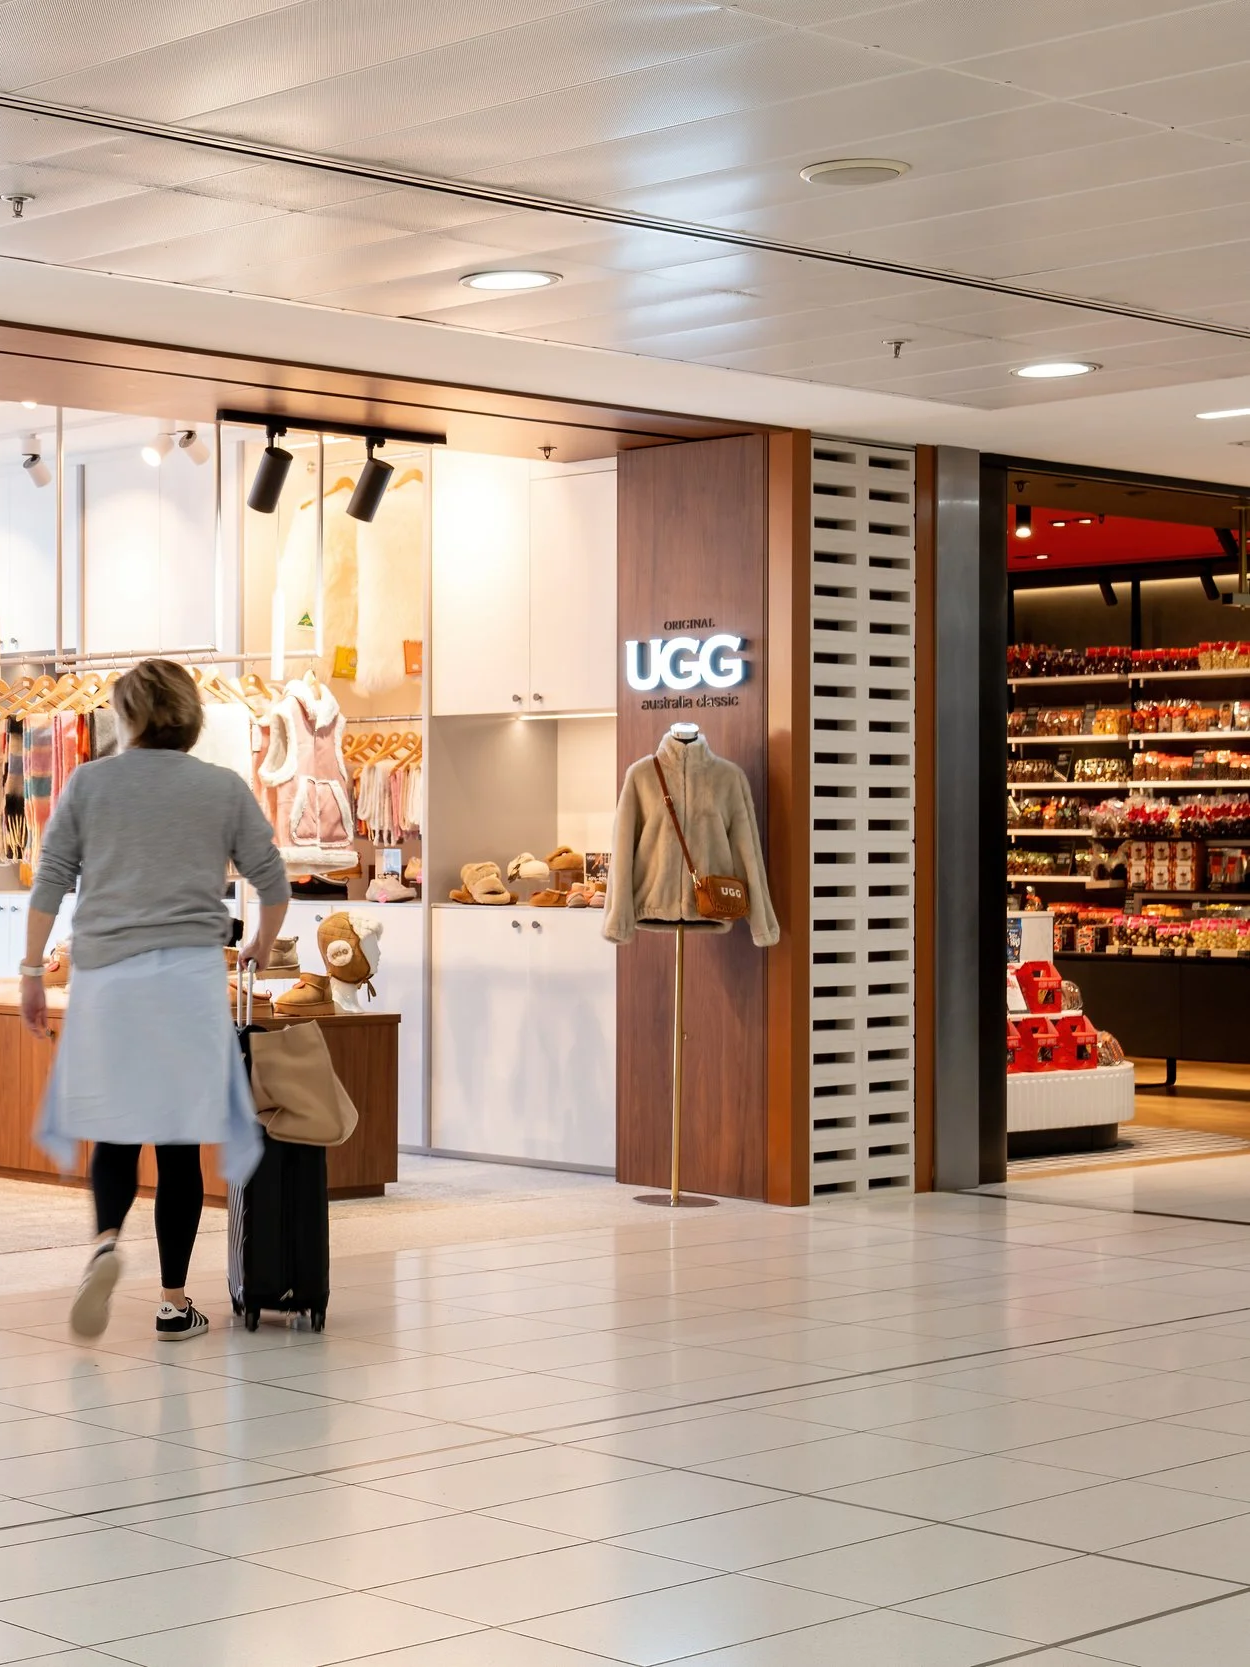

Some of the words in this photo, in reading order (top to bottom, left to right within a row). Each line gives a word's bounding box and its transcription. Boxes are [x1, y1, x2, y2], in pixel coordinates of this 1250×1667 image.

[663, 618, 716, 631] ORIGINAL
[625, 634, 744, 691] UGG
[641, 695, 693, 711] australia
[696, 693, 739, 708] classic
[720, 886, 742, 899] UGG
